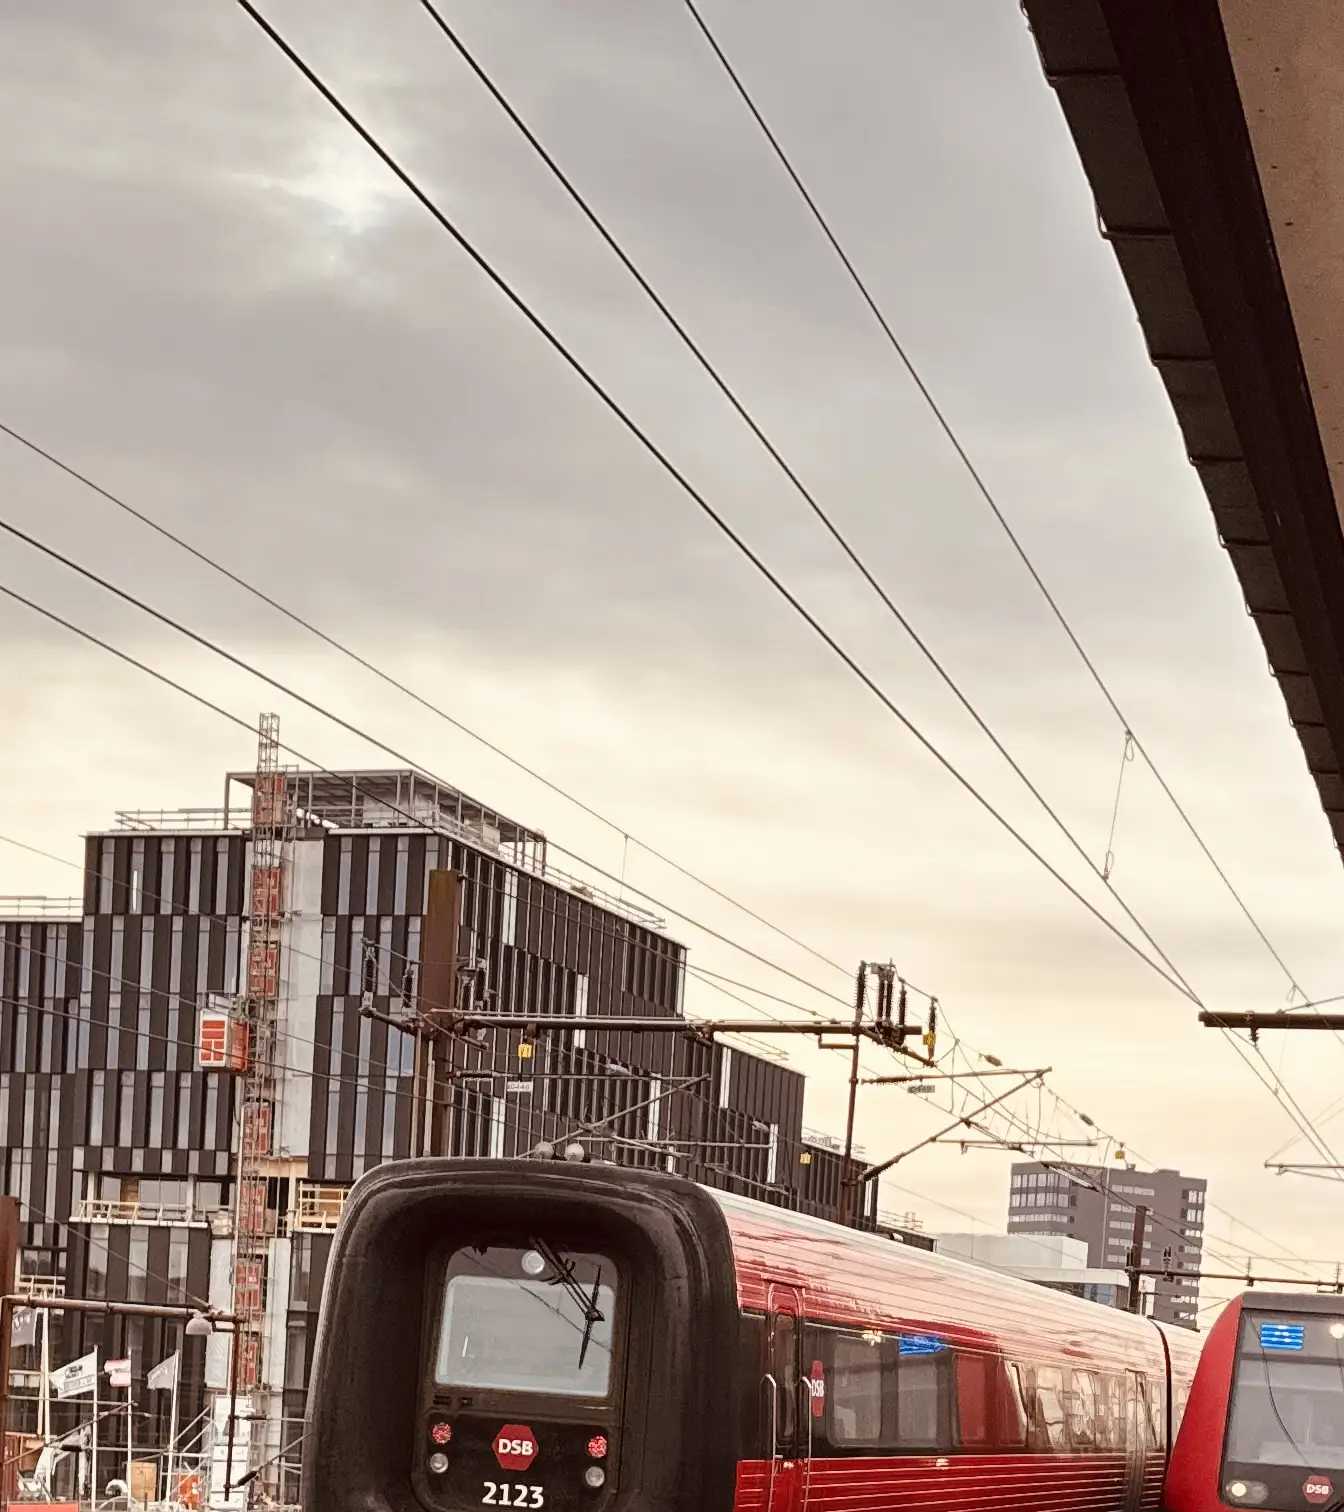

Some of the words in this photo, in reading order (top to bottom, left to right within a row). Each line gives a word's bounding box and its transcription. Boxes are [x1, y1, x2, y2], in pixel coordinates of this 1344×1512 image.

[498, 1438, 533, 1456] DSB
[482, 1481, 544, 1509] 2123
[1306, 1483, 1330, 1495] DSB
